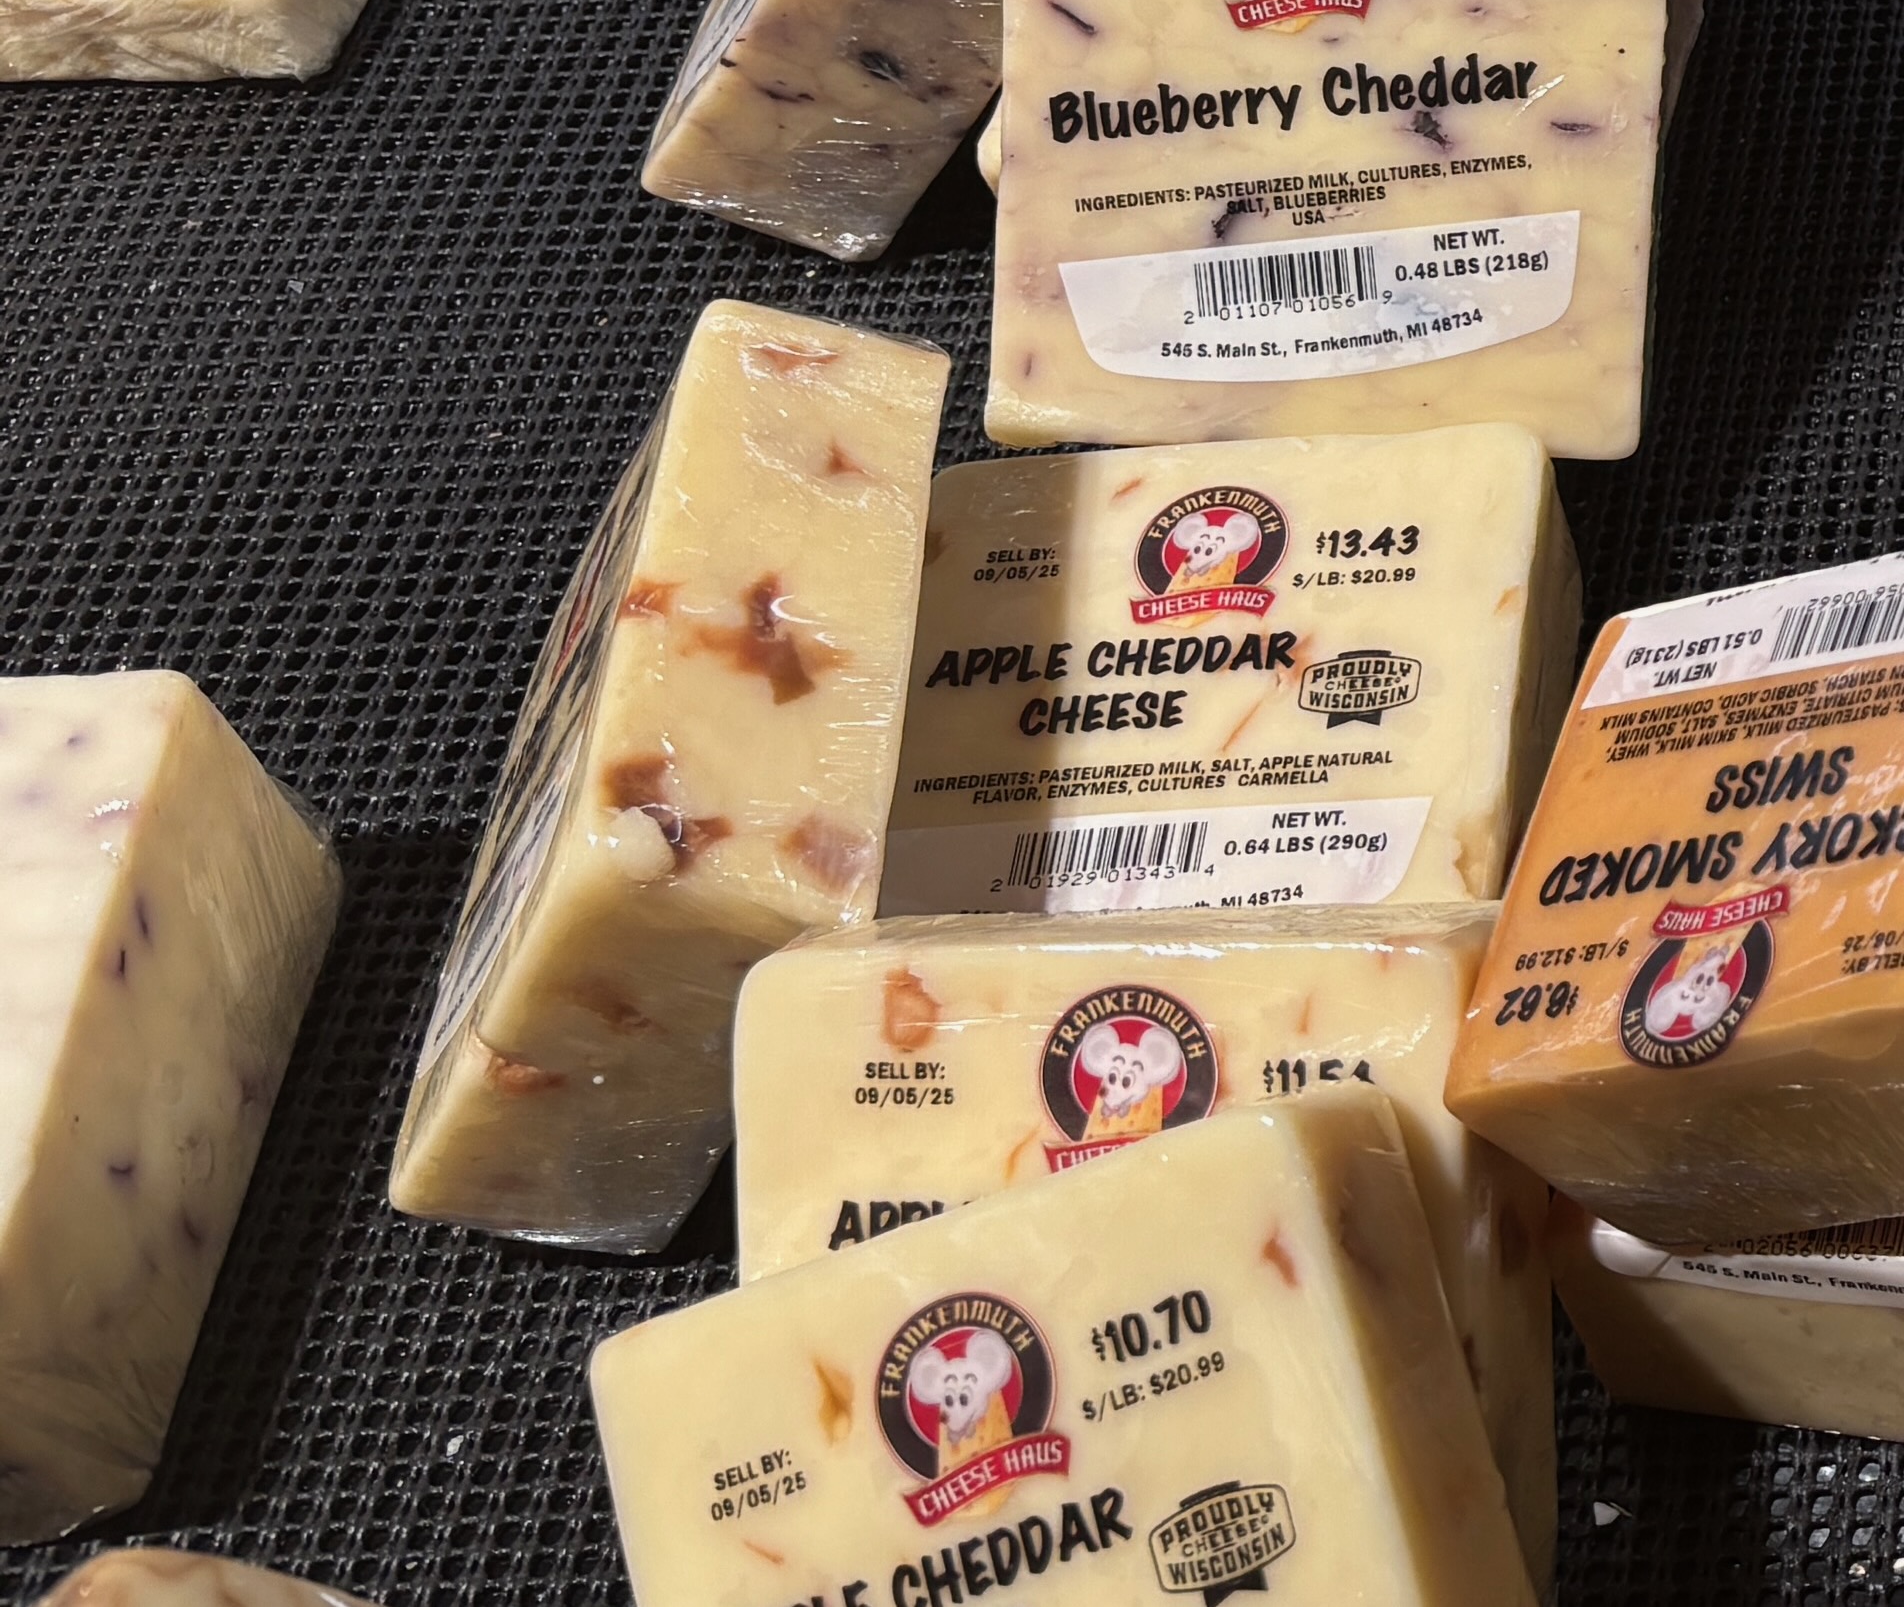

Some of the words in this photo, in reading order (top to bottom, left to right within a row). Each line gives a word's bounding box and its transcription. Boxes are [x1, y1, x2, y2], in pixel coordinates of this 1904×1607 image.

[1048, 81, 1302, 144] Blueberry
[1321, 53, 1538, 116] Cheddar
[1433, 231, 1468, 250] NET
[1470, 229, 1505, 246] WT.
[1394, 262, 1440, 281] 0.48
[1443, 258, 1482, 278] LBS
[1484, 250, 1550, 278] (218g)
[1197, 341, 1213, 357] S.
[1216, 343, 1255, 359] Main
[1259, 340, 1288, 359] St.,
[1294, 326, 1404, 356] Frankenmuth,
[1406, 320, 1427, 338] MI
[1431, 308, 1483, 331] 48734
[1315, 525, 1421, 560] $13.43
[926, 641, 1073, 689] APPLE
[1086, 630, 1298, 679] CHEDDAR
[1310, 658, 1413, 682] PROUDLY
[1019, 690, 1187, 737] CHEESE
[1307, 684, 1410, 710] WISCONSIN
[1705, 746, 1856, 815] SWISS
[1538, 830, 1744, 907] SMOKED
[1090, 1290, 1212, 1364] $10.70
[892, 1488, 1134, 1607] CHEDDAR
